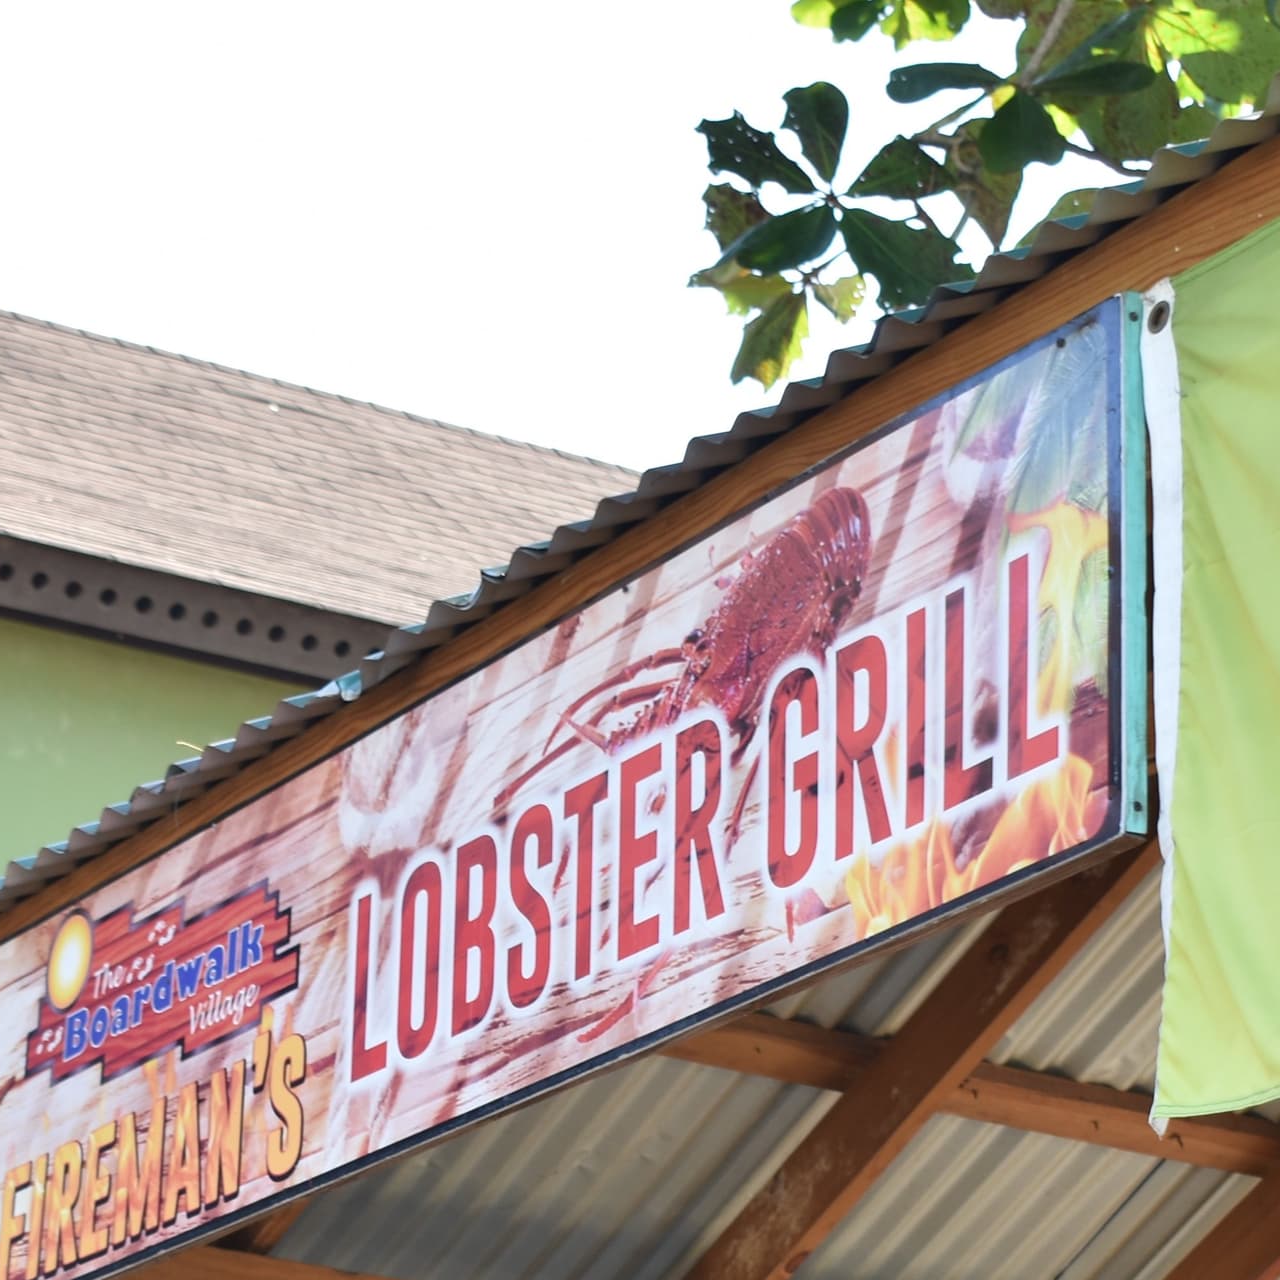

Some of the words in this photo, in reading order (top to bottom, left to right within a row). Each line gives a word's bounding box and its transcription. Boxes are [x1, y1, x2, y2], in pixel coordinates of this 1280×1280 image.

[350, 718, 726, 1083] LOBSTER
[766, 554, 1061, 889] GRILL
[62, 920, 264, 1061] Boardwalk
[93, 961, 124, 998] The
[188, 980, 261, 1036] Village
